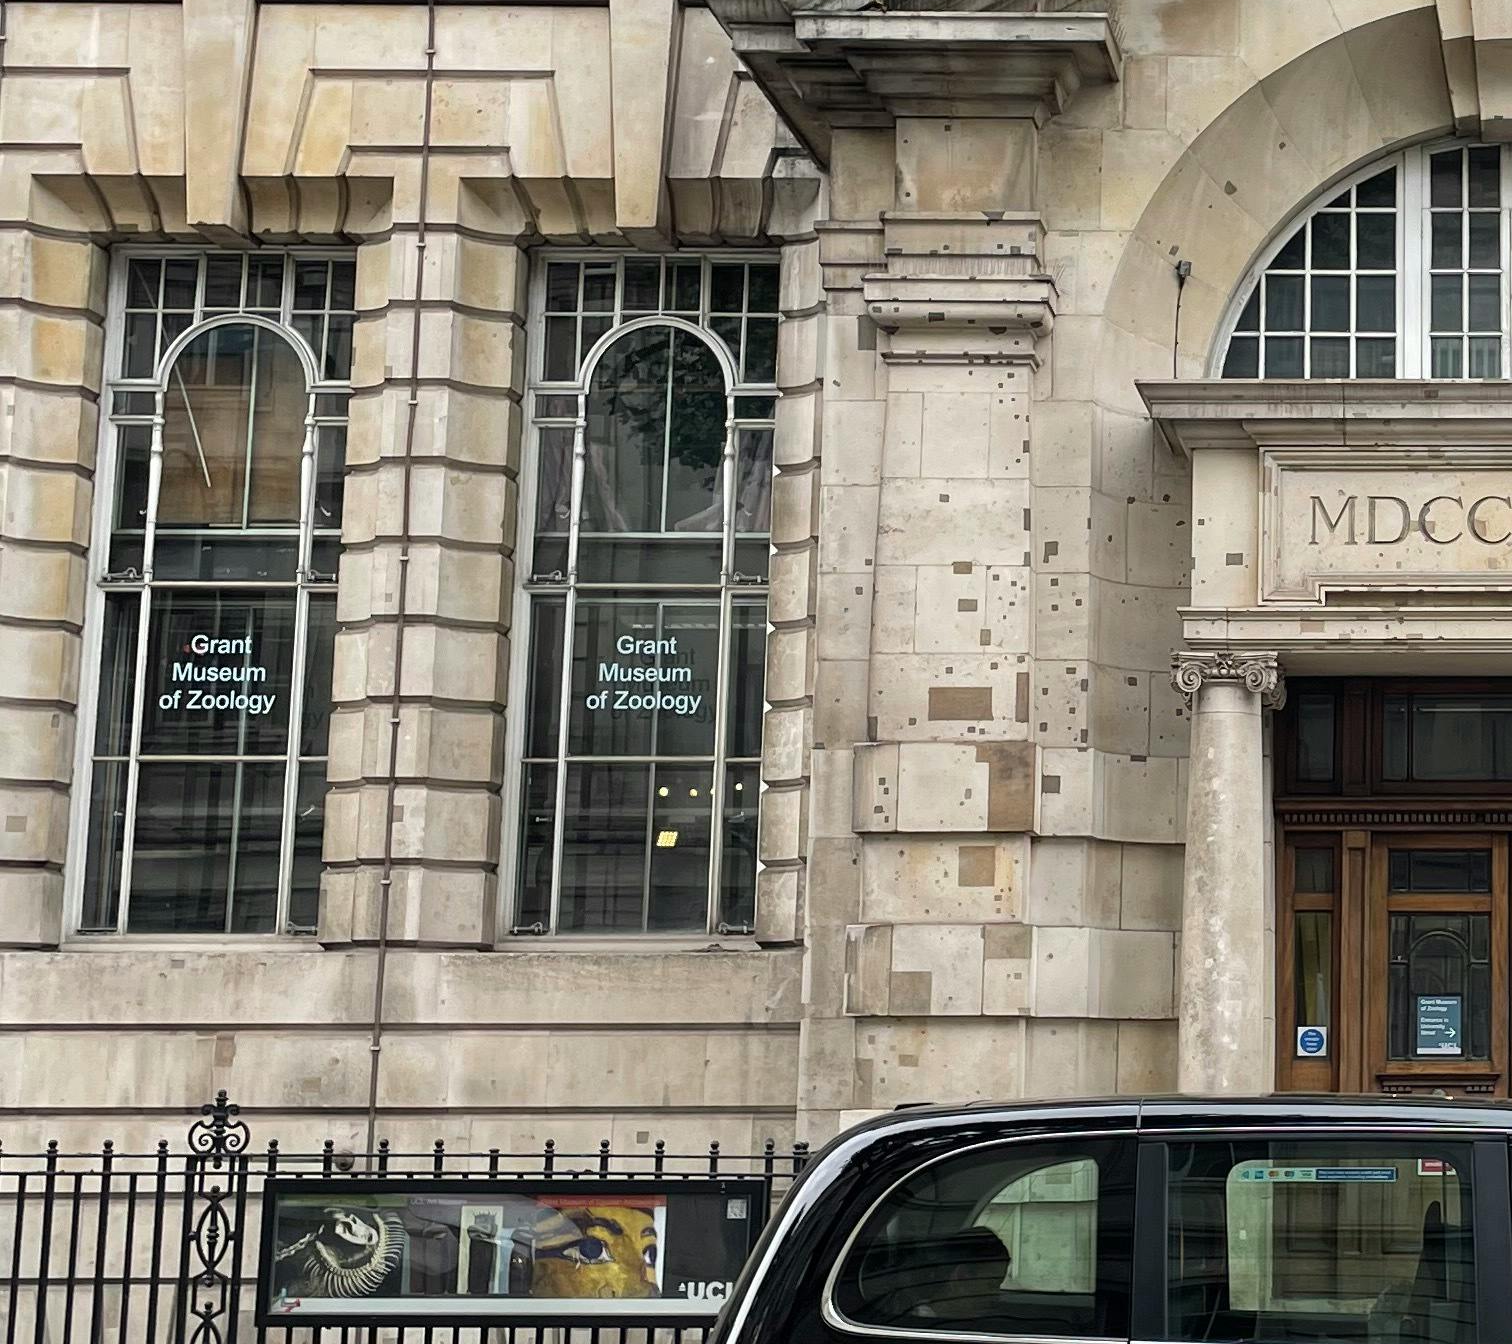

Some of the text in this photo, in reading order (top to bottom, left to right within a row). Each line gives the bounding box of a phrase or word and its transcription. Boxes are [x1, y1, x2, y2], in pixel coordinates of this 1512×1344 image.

[191, 634, 253, 655] Grant
[616, 635, 678, 655] Grant
[172, 662, 266, 682] Museum
[598, 662, 692, 682] Museum
[158, 689, 276, 714] of Zoology
[586, 690, 702, 714] of Zoology
